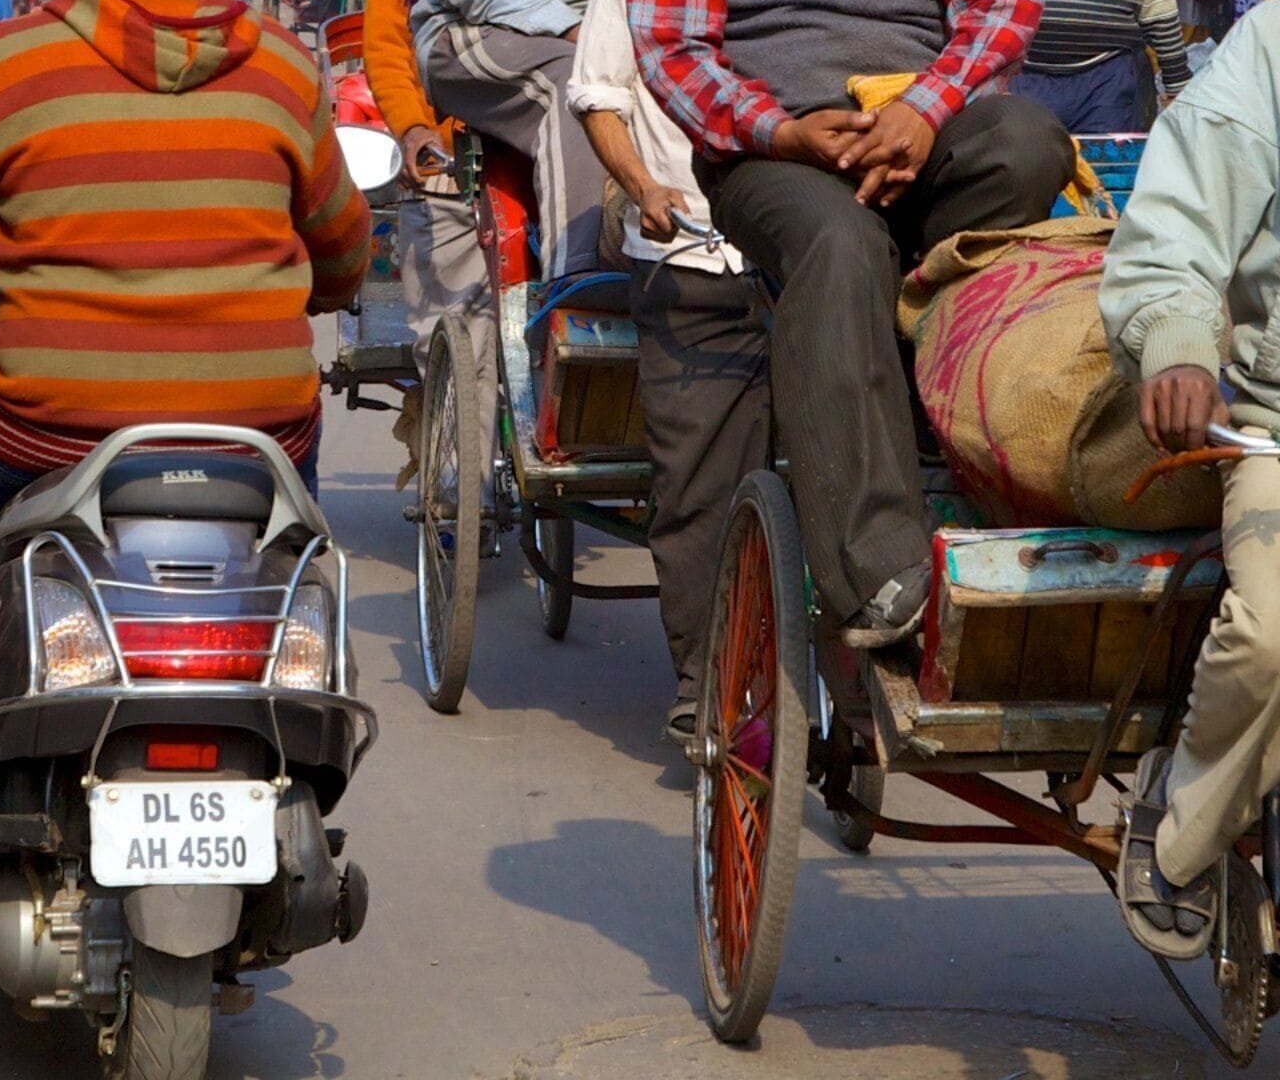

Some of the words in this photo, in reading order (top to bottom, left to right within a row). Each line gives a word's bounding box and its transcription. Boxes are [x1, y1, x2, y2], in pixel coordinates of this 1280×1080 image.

[143, 793, 180, 823] DL
[190, 792, 225, 822] 6S
[126, 838, 167, 869] AH
[178, 836, 247, 868] 4550
